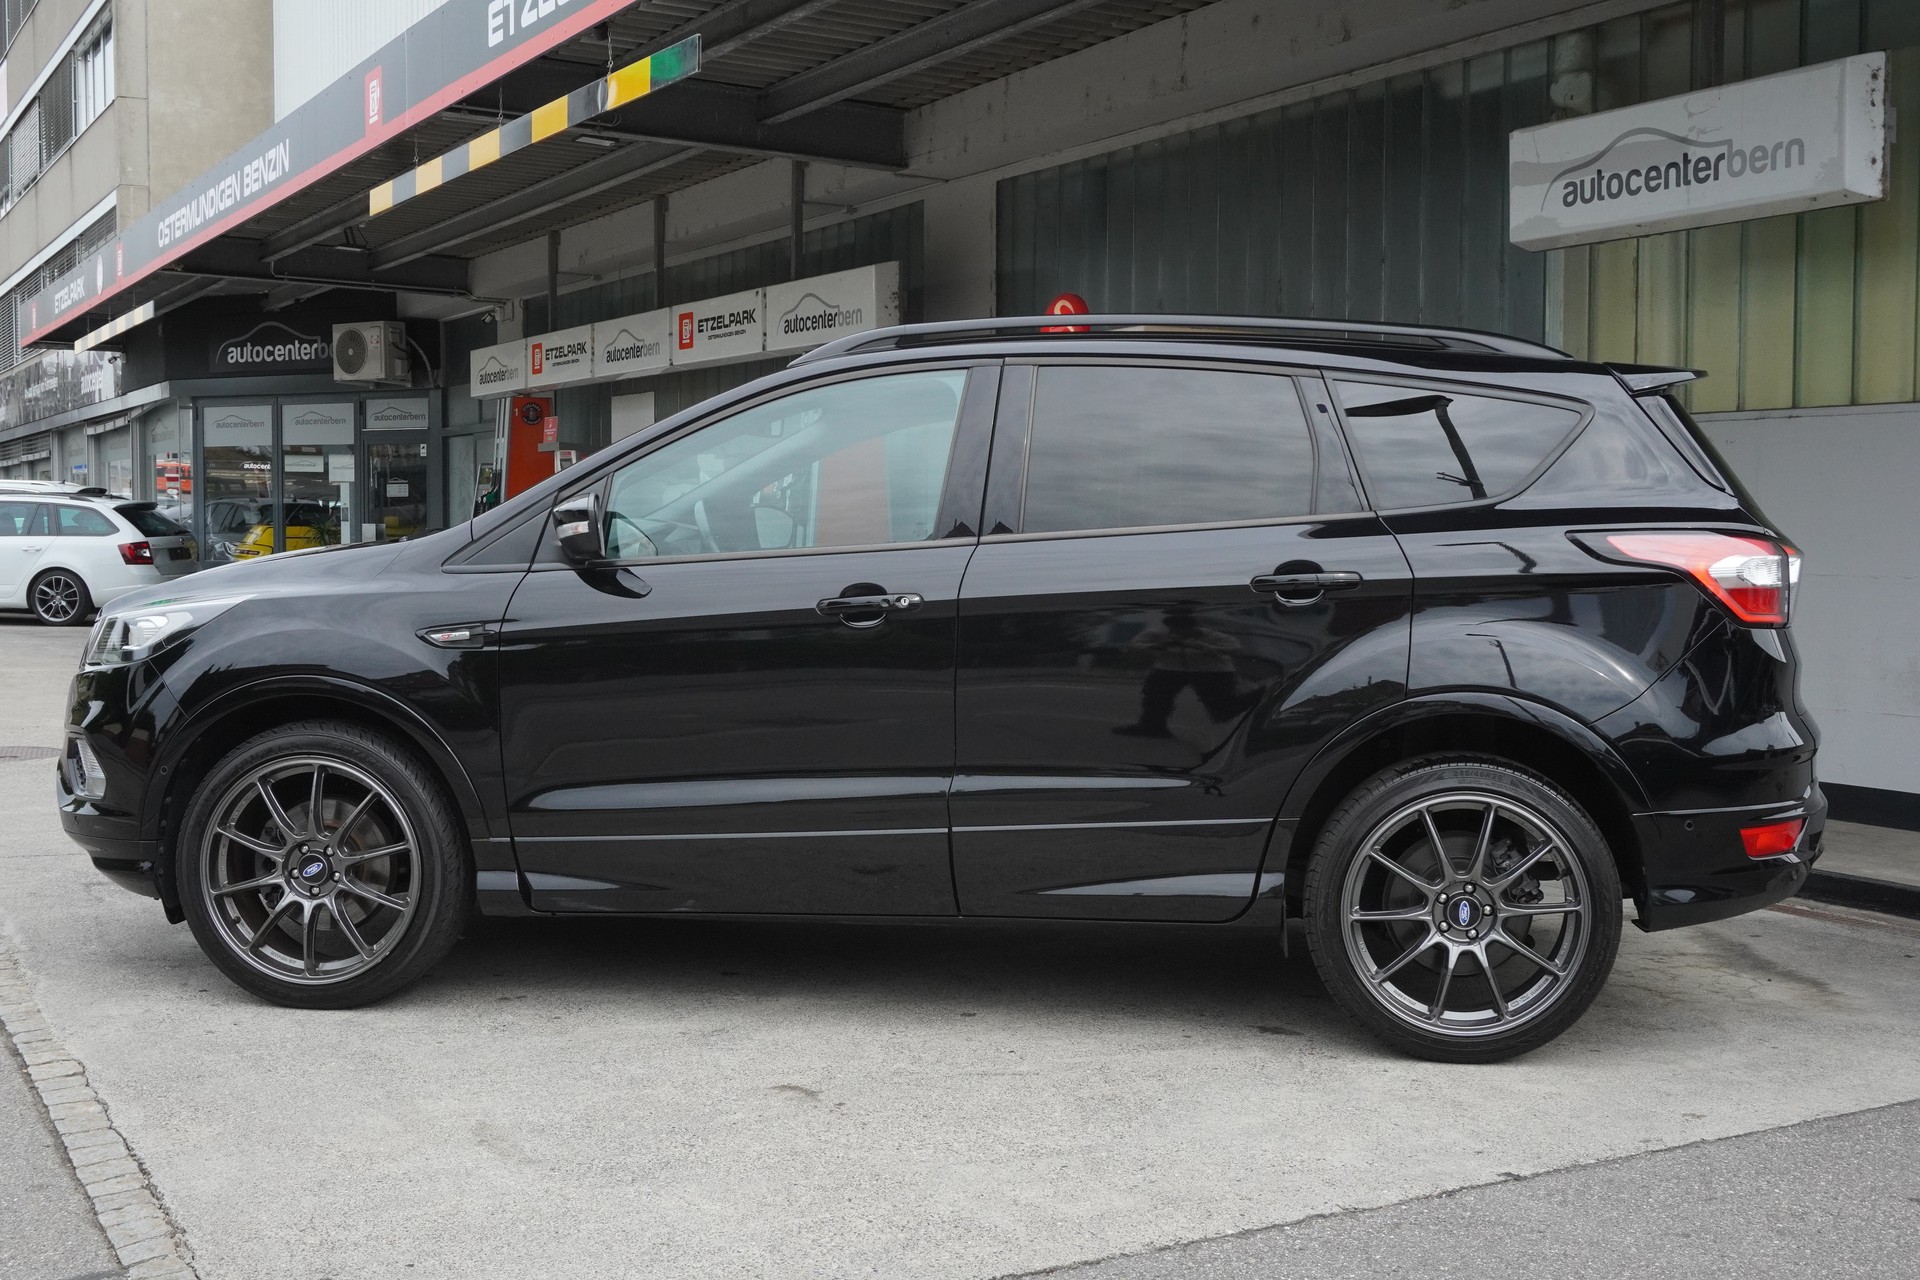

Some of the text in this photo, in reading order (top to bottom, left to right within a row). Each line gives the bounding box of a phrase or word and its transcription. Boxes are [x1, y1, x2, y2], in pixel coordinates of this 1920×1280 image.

[1562, 138, 1805, 208] autocenterbern
[158, 138, 289, 248] OSTERMUNDIGEN BENZIN
[54, 275, 85, 314] ETZELPARK
[697, 308, 756, 333] ETZELPARK
[783, 306, 863, 334] autocenterbern
[545, 341, 588, 361] ETZELPARK
[606, 340, 660, 363] autocenterbern
[479, 366, 519, 385] autocenterbern
[295, 417, 346, 425] autocenterbern
[374, 413, 426, 422] autocenterbern
[514, 408, 519, 416] 1
[216, 420, 264, 428] autocenterbern
